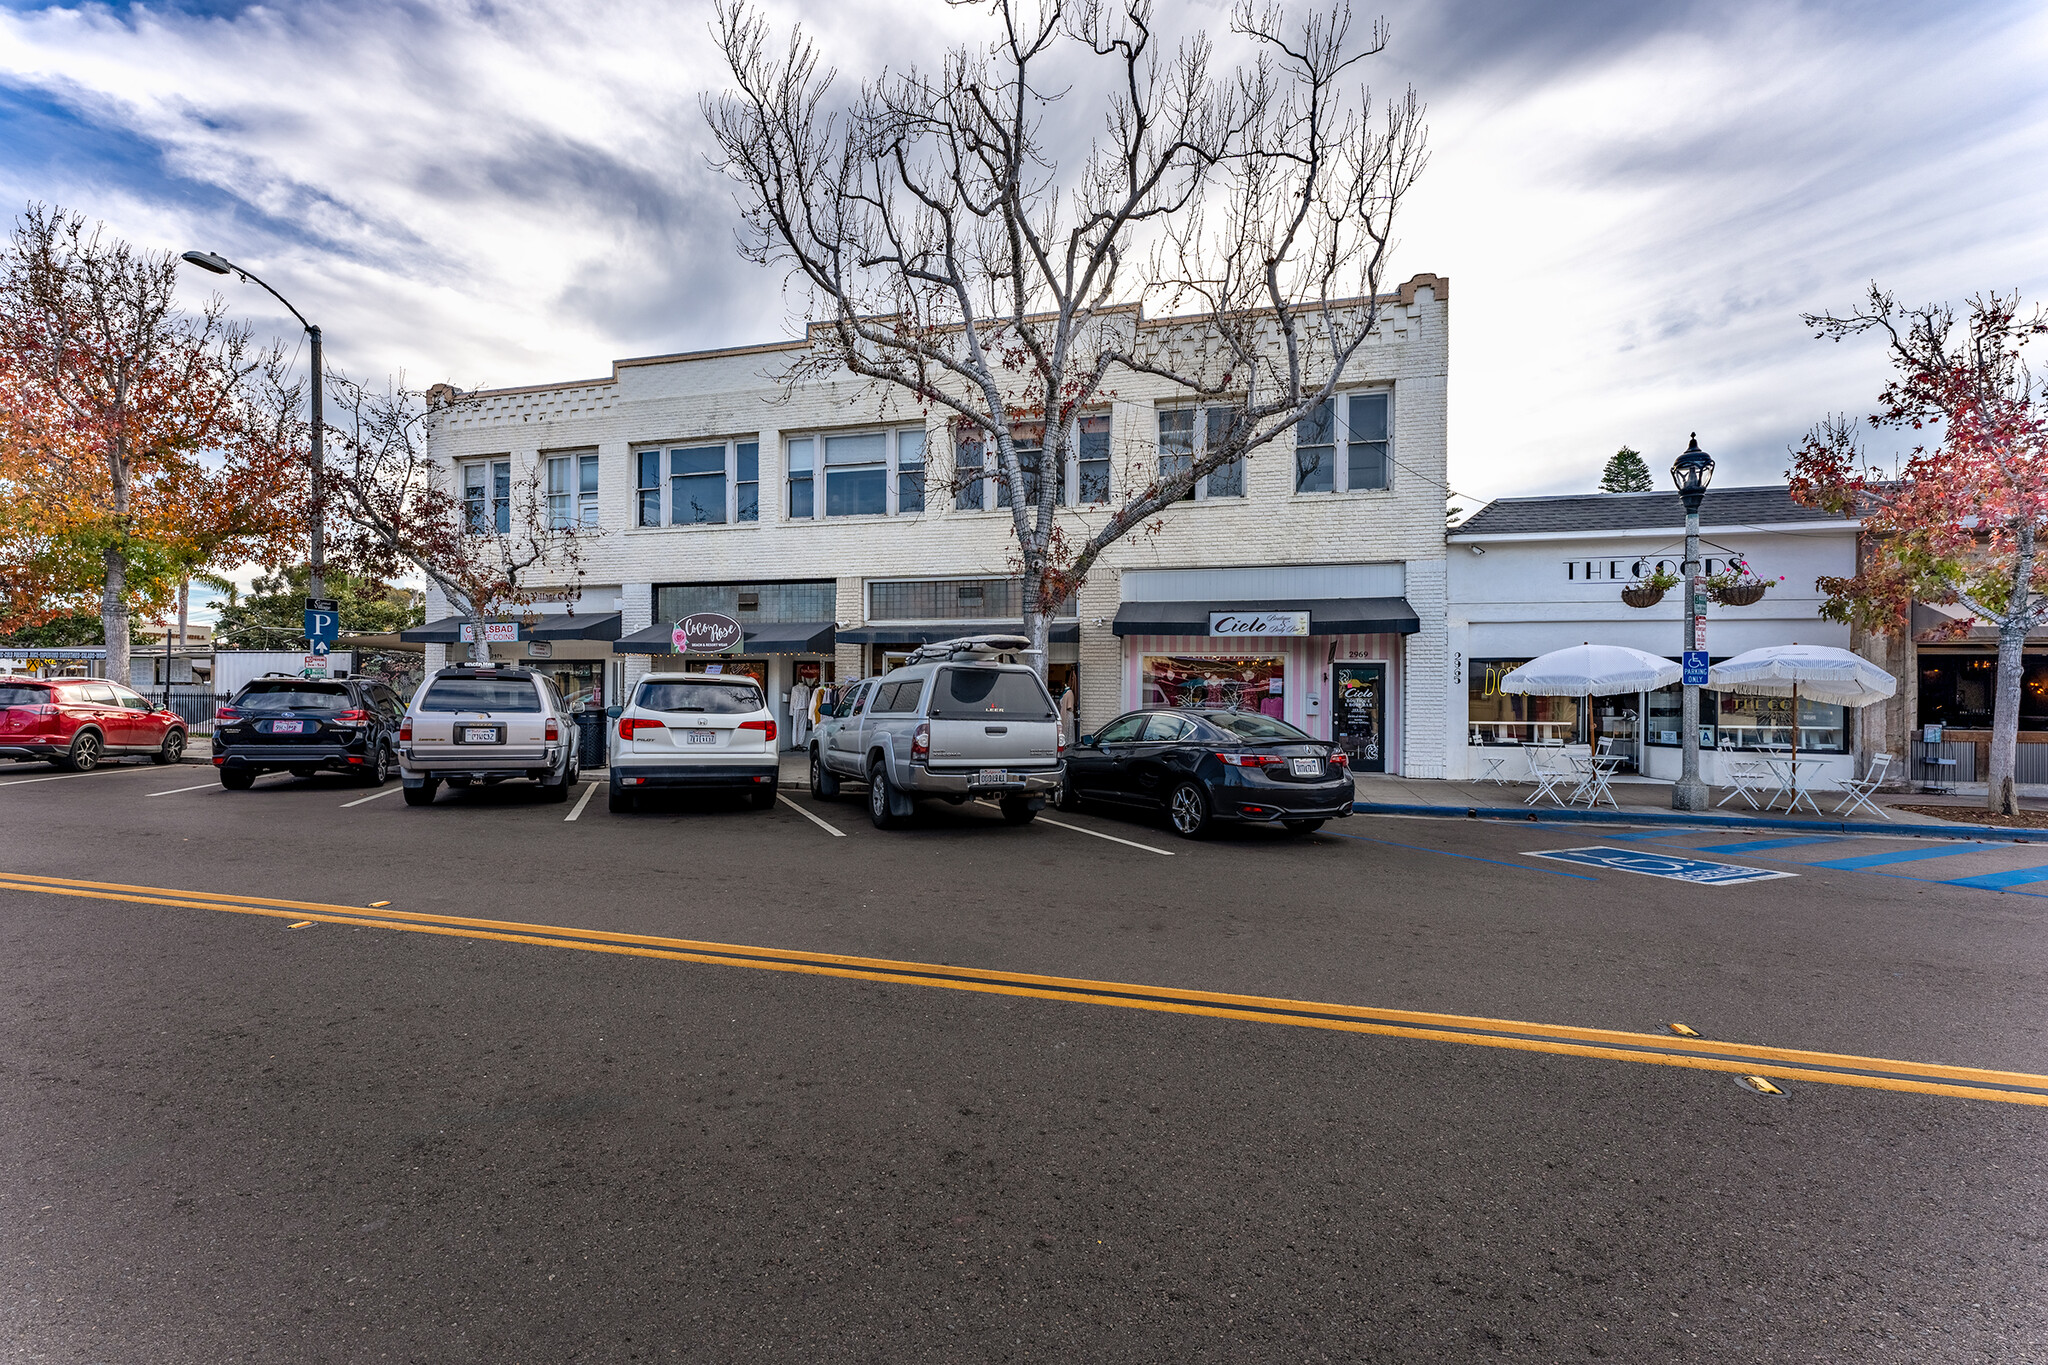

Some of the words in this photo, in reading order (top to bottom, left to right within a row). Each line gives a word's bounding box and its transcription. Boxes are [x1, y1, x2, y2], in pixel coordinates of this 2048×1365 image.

[1563, 561, 1625, 580] THE
[313, 614, 332, 636] P
[465, 625, 513, 634] CSBAD
[685, 618, 708, 636] Coco
[710, 623, 737, 642] Rose
[1214, 616, 1267, 633] Cielo
[493, 633, 515, 641] COINS
[1349, 650, 1369, 658] 2969
[1453, 651, 1462, 685] 2965
[1344, 688, 1374, 698] Cielo
[1703, 732, 1710, 741] A
